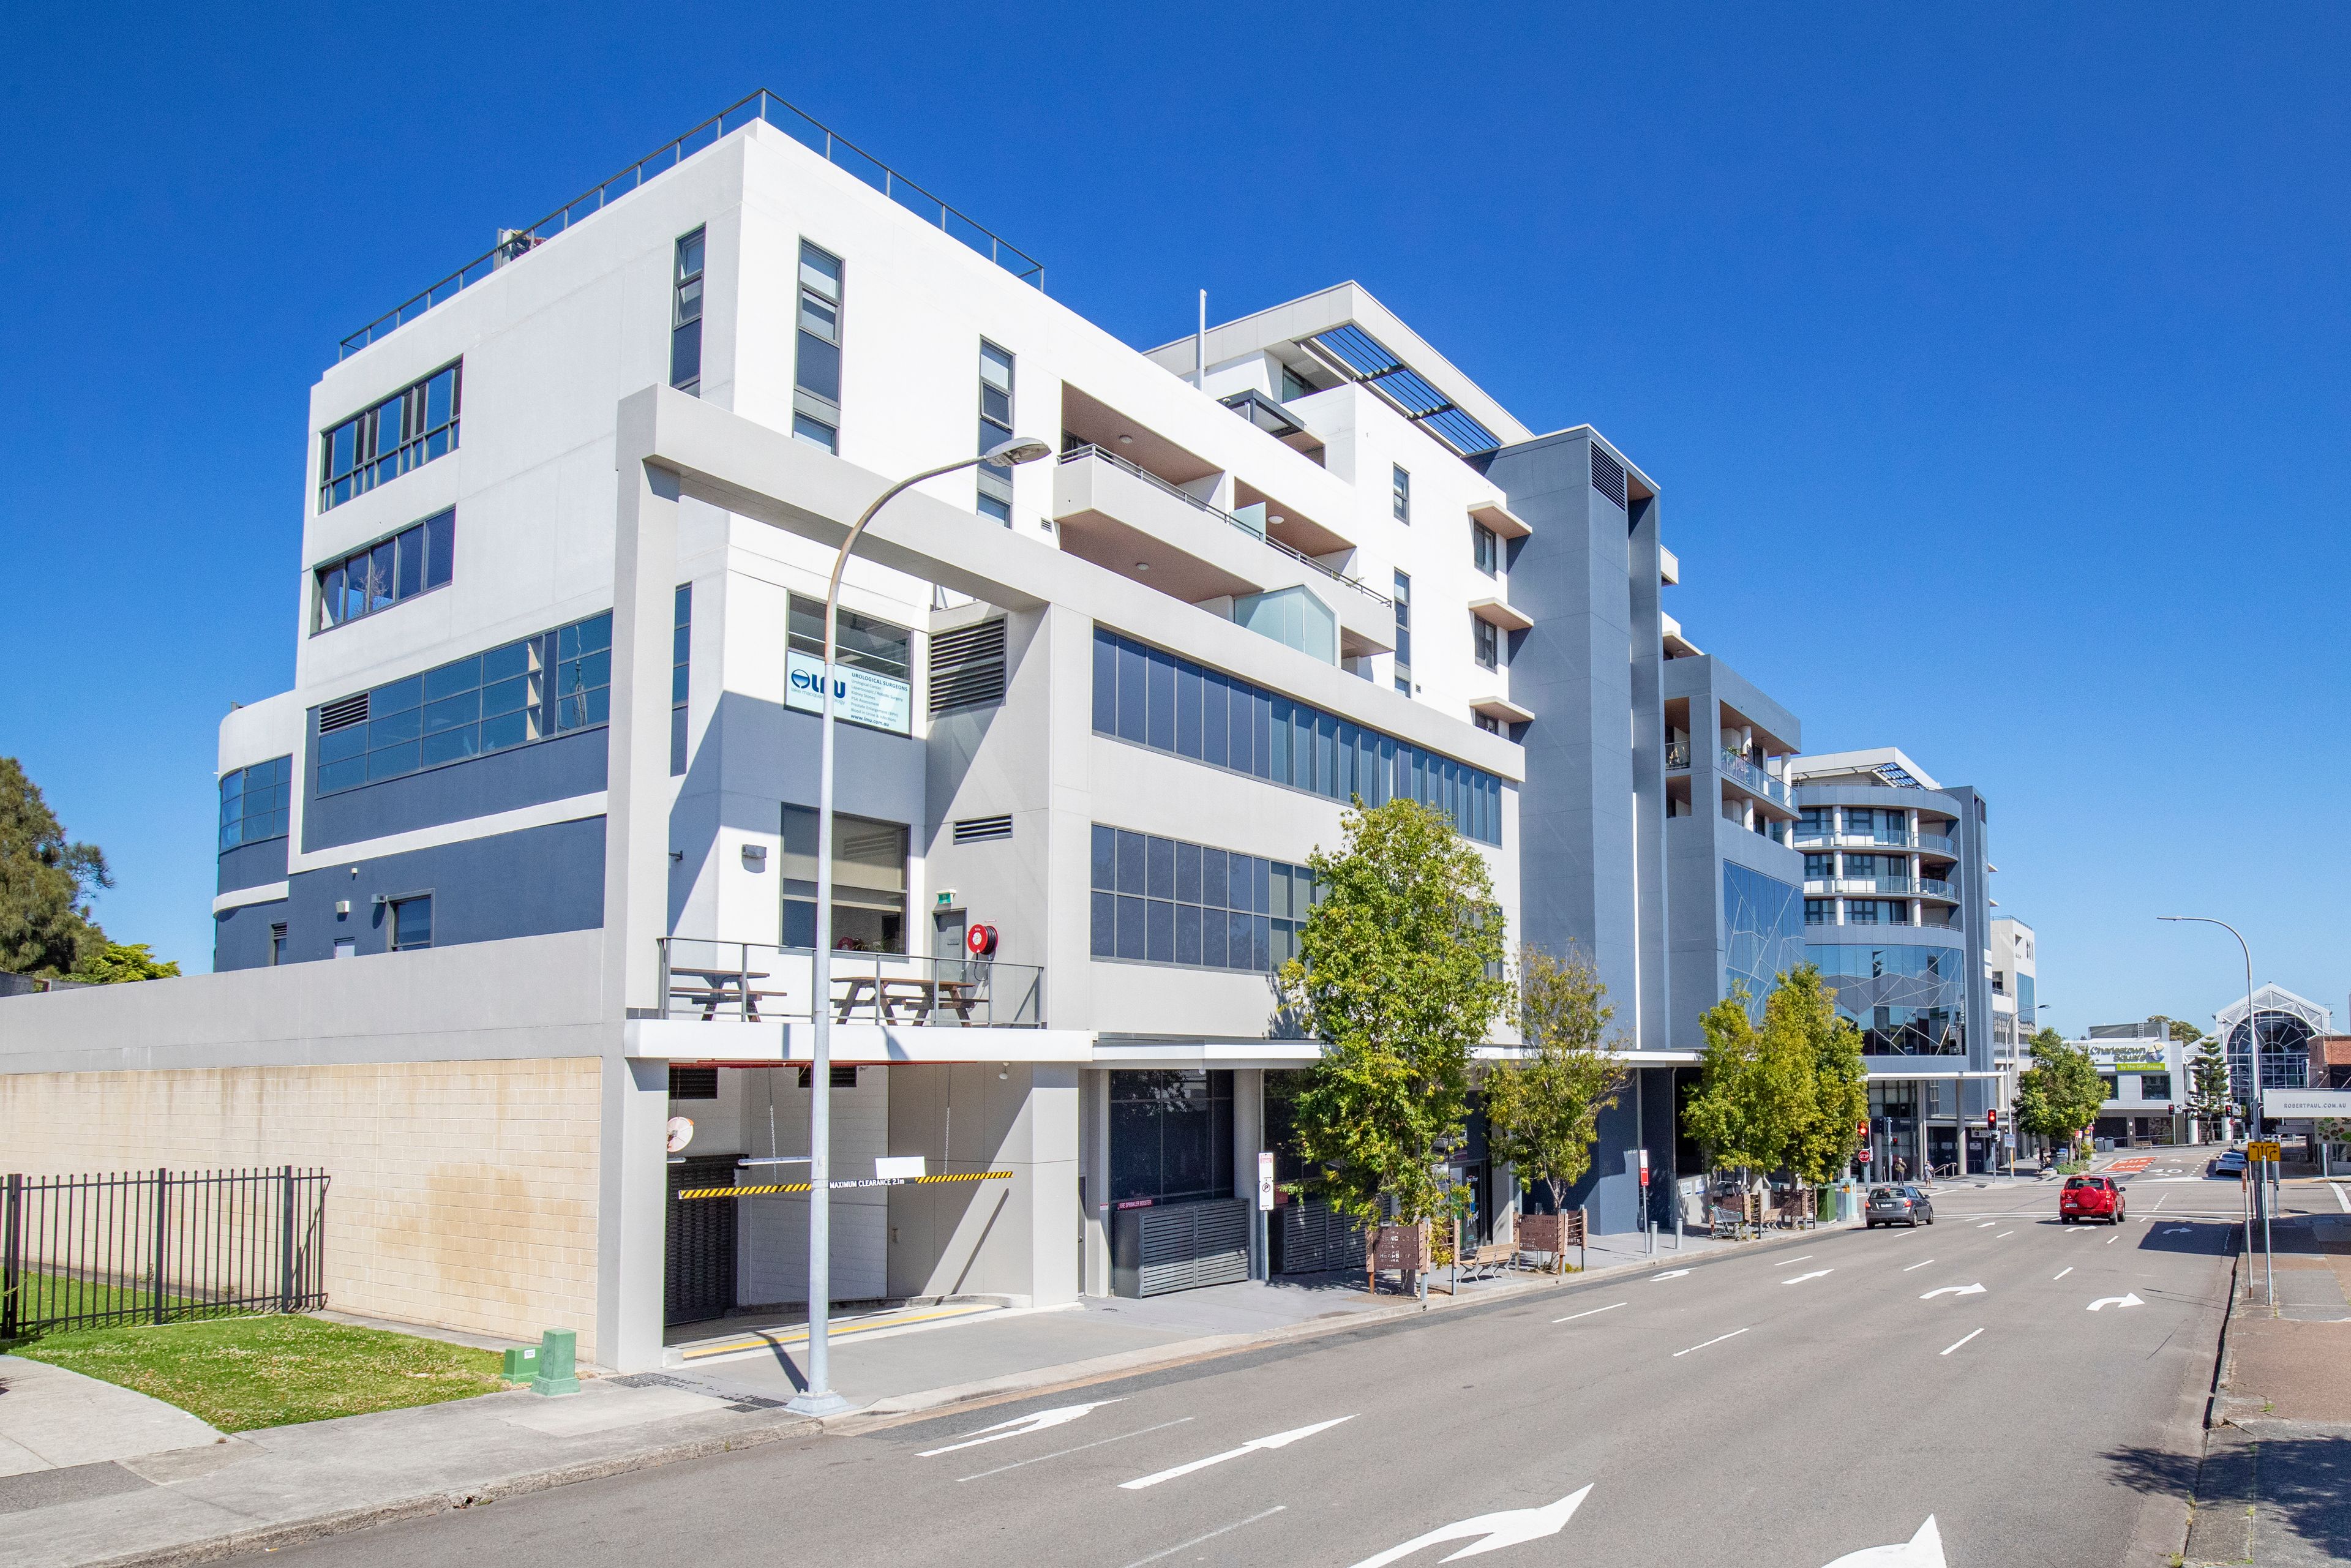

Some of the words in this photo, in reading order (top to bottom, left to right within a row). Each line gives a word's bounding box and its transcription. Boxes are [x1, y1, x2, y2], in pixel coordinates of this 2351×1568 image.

[852, 672, 882, 685] UROLOGICAL
[883, 681, 908, 691] SURGEONS
[859, 698, 879, 707] Assessment
[850, 714, 890, 727] www.lmu.com.au
[2090, 1046, 2146, 1055] Charlestown
[2113, 1054, 2146, 1062] Square
